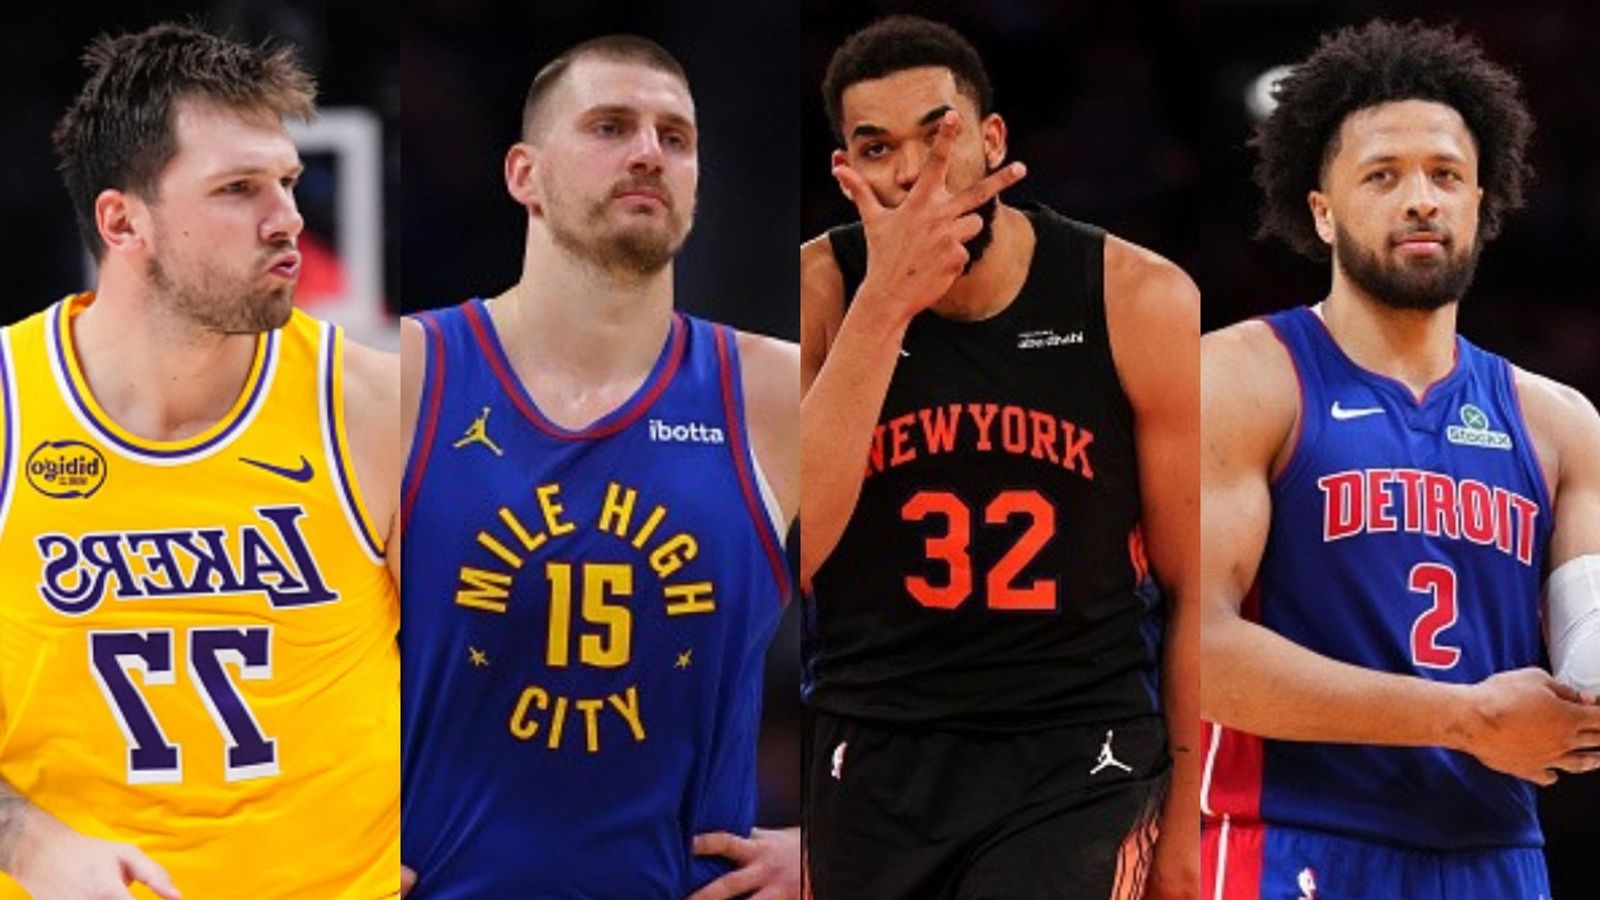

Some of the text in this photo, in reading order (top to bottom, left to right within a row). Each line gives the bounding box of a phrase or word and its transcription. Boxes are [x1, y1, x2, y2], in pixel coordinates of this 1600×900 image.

[649, 419, 725, 444] ibotta
[864, 403, 1095, 482] NEW YORK
[454, 481, 716, 617] MILE HIGH
[900, 489, 1058, 612] 32
[1319, 469, 1539, 565] DETROIT
[545, 562, 634, 668] 15
[1408, 563, 1461, 671] 2
[509, 685, 648, 753] CITY
